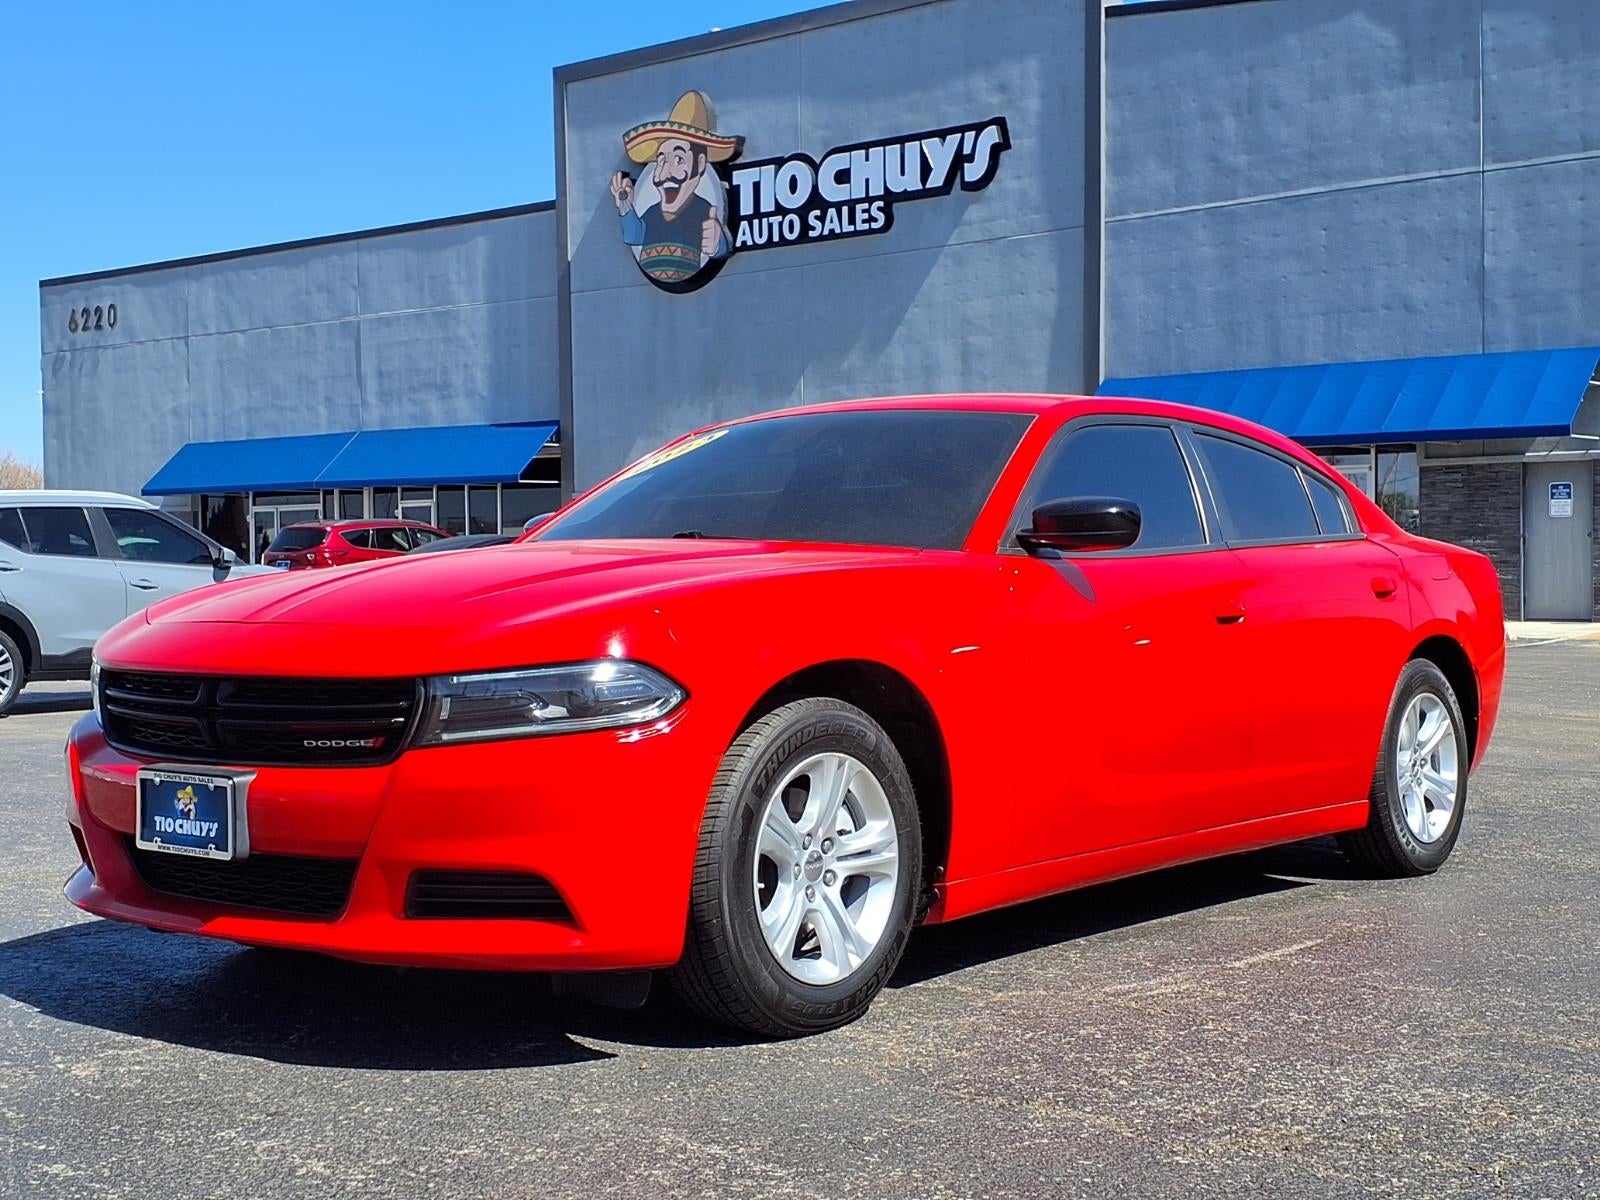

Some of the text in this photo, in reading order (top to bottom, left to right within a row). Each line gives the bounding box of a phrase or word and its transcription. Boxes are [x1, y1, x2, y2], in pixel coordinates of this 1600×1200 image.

[732, 124, 1000, 216] TIO CHUY'S
[735, 201, 887, 247] AUTO SALES
[68, 303, 118, 334] 6220
[303, 739, 374, 747] DODGE
[154, 815, 218, 838] TIO CHUY'S
